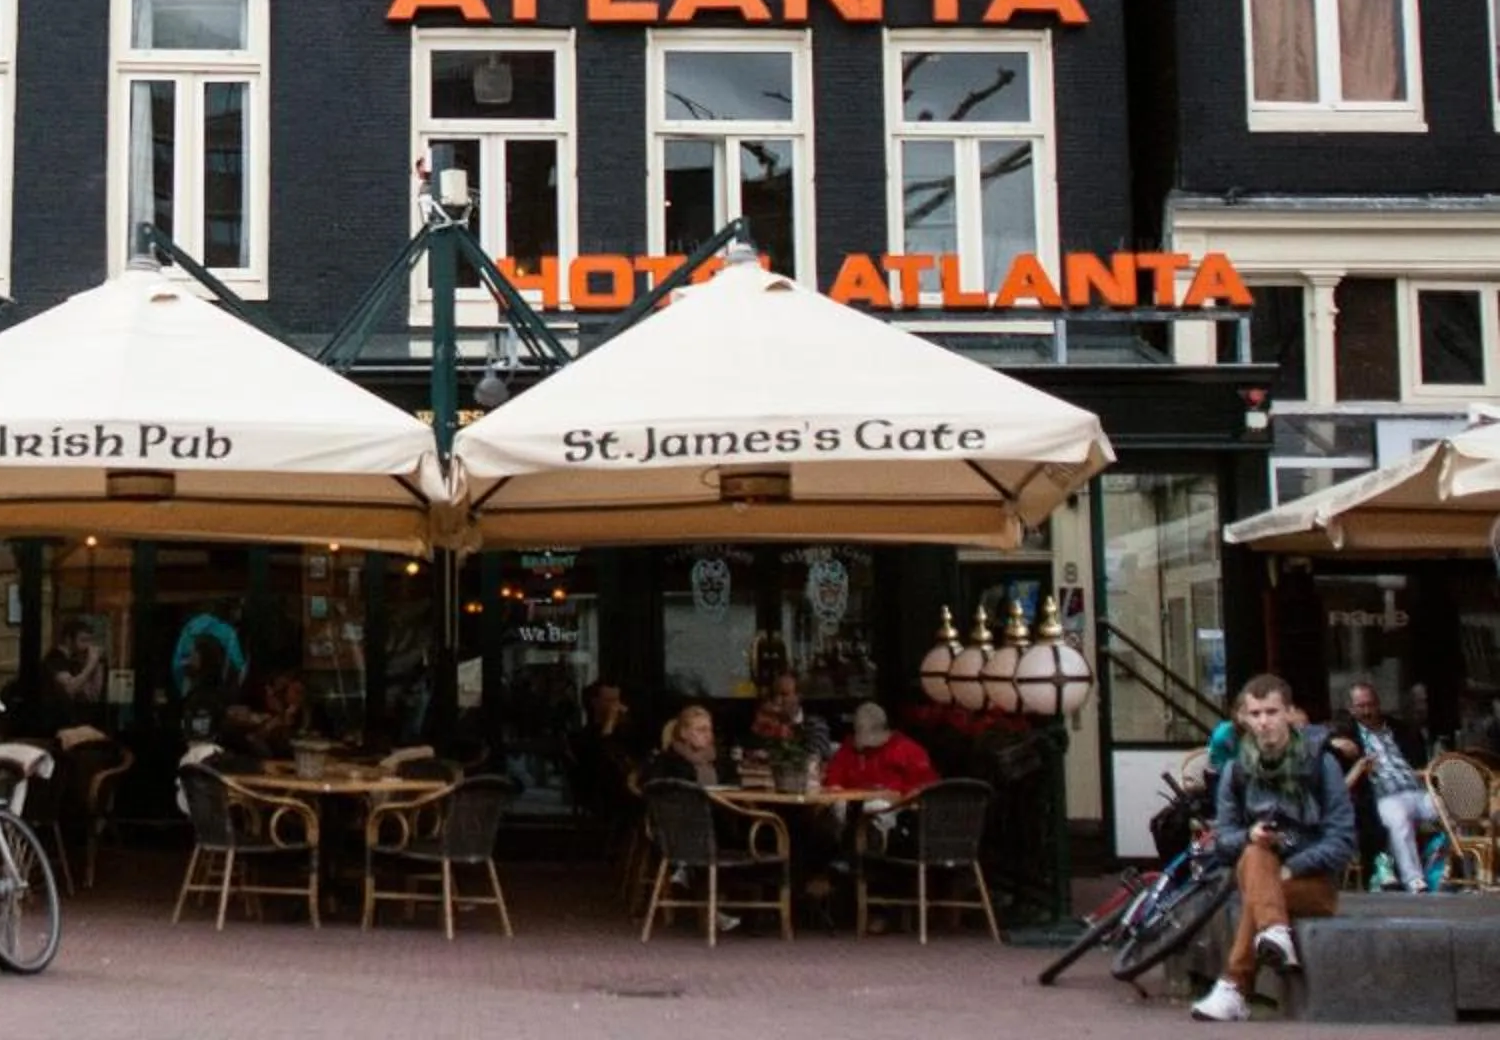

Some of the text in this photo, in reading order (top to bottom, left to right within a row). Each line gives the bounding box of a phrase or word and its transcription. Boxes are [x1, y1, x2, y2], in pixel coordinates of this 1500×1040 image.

[497, 252, 1255, 312] HOT ATLANTA
[138, 423, 233, 460] Pub
[853, 419, 987, 452] Gate
